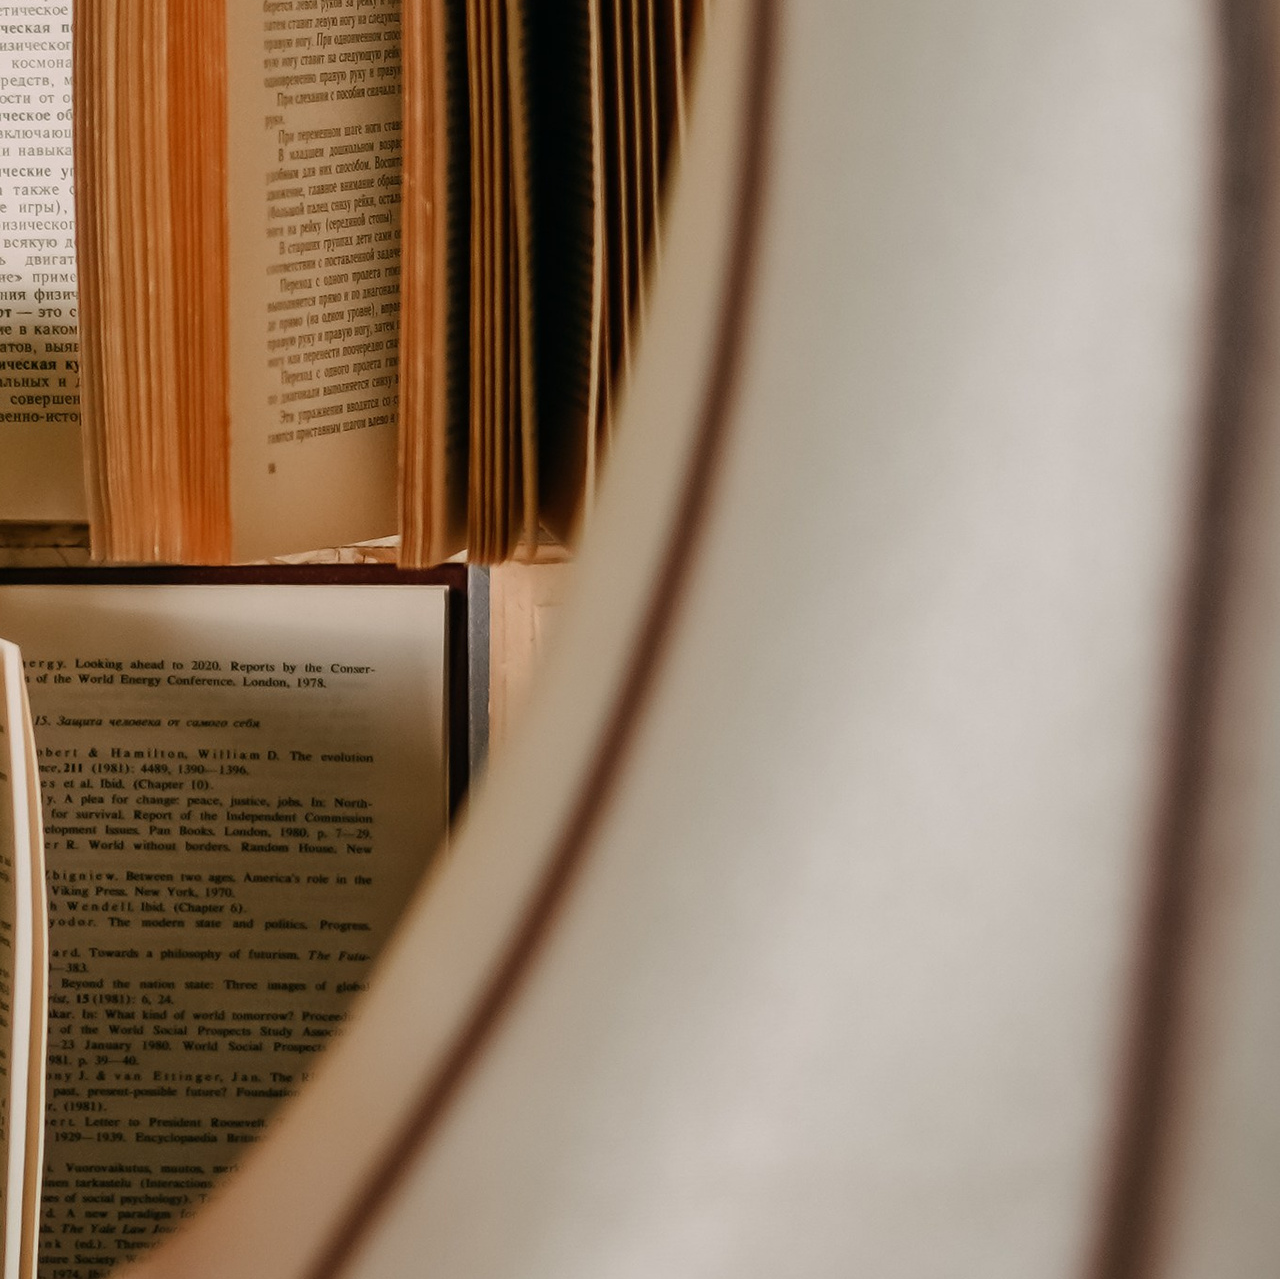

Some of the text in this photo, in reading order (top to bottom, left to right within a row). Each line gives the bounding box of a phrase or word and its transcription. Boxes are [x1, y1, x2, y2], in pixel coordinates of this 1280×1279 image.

[38, 308, 62, 318] это
[75, 658, 322, 674] Looking ahead to 2020. Reports by the
[54, 674, 72, 684] the
[78, 674, 114, 684] World
[120, 674, 161, 687] Energy
[167, 675, 236, 686] Conference.
[105, 1009, 294, 1021] What kind of world tomorrow?
